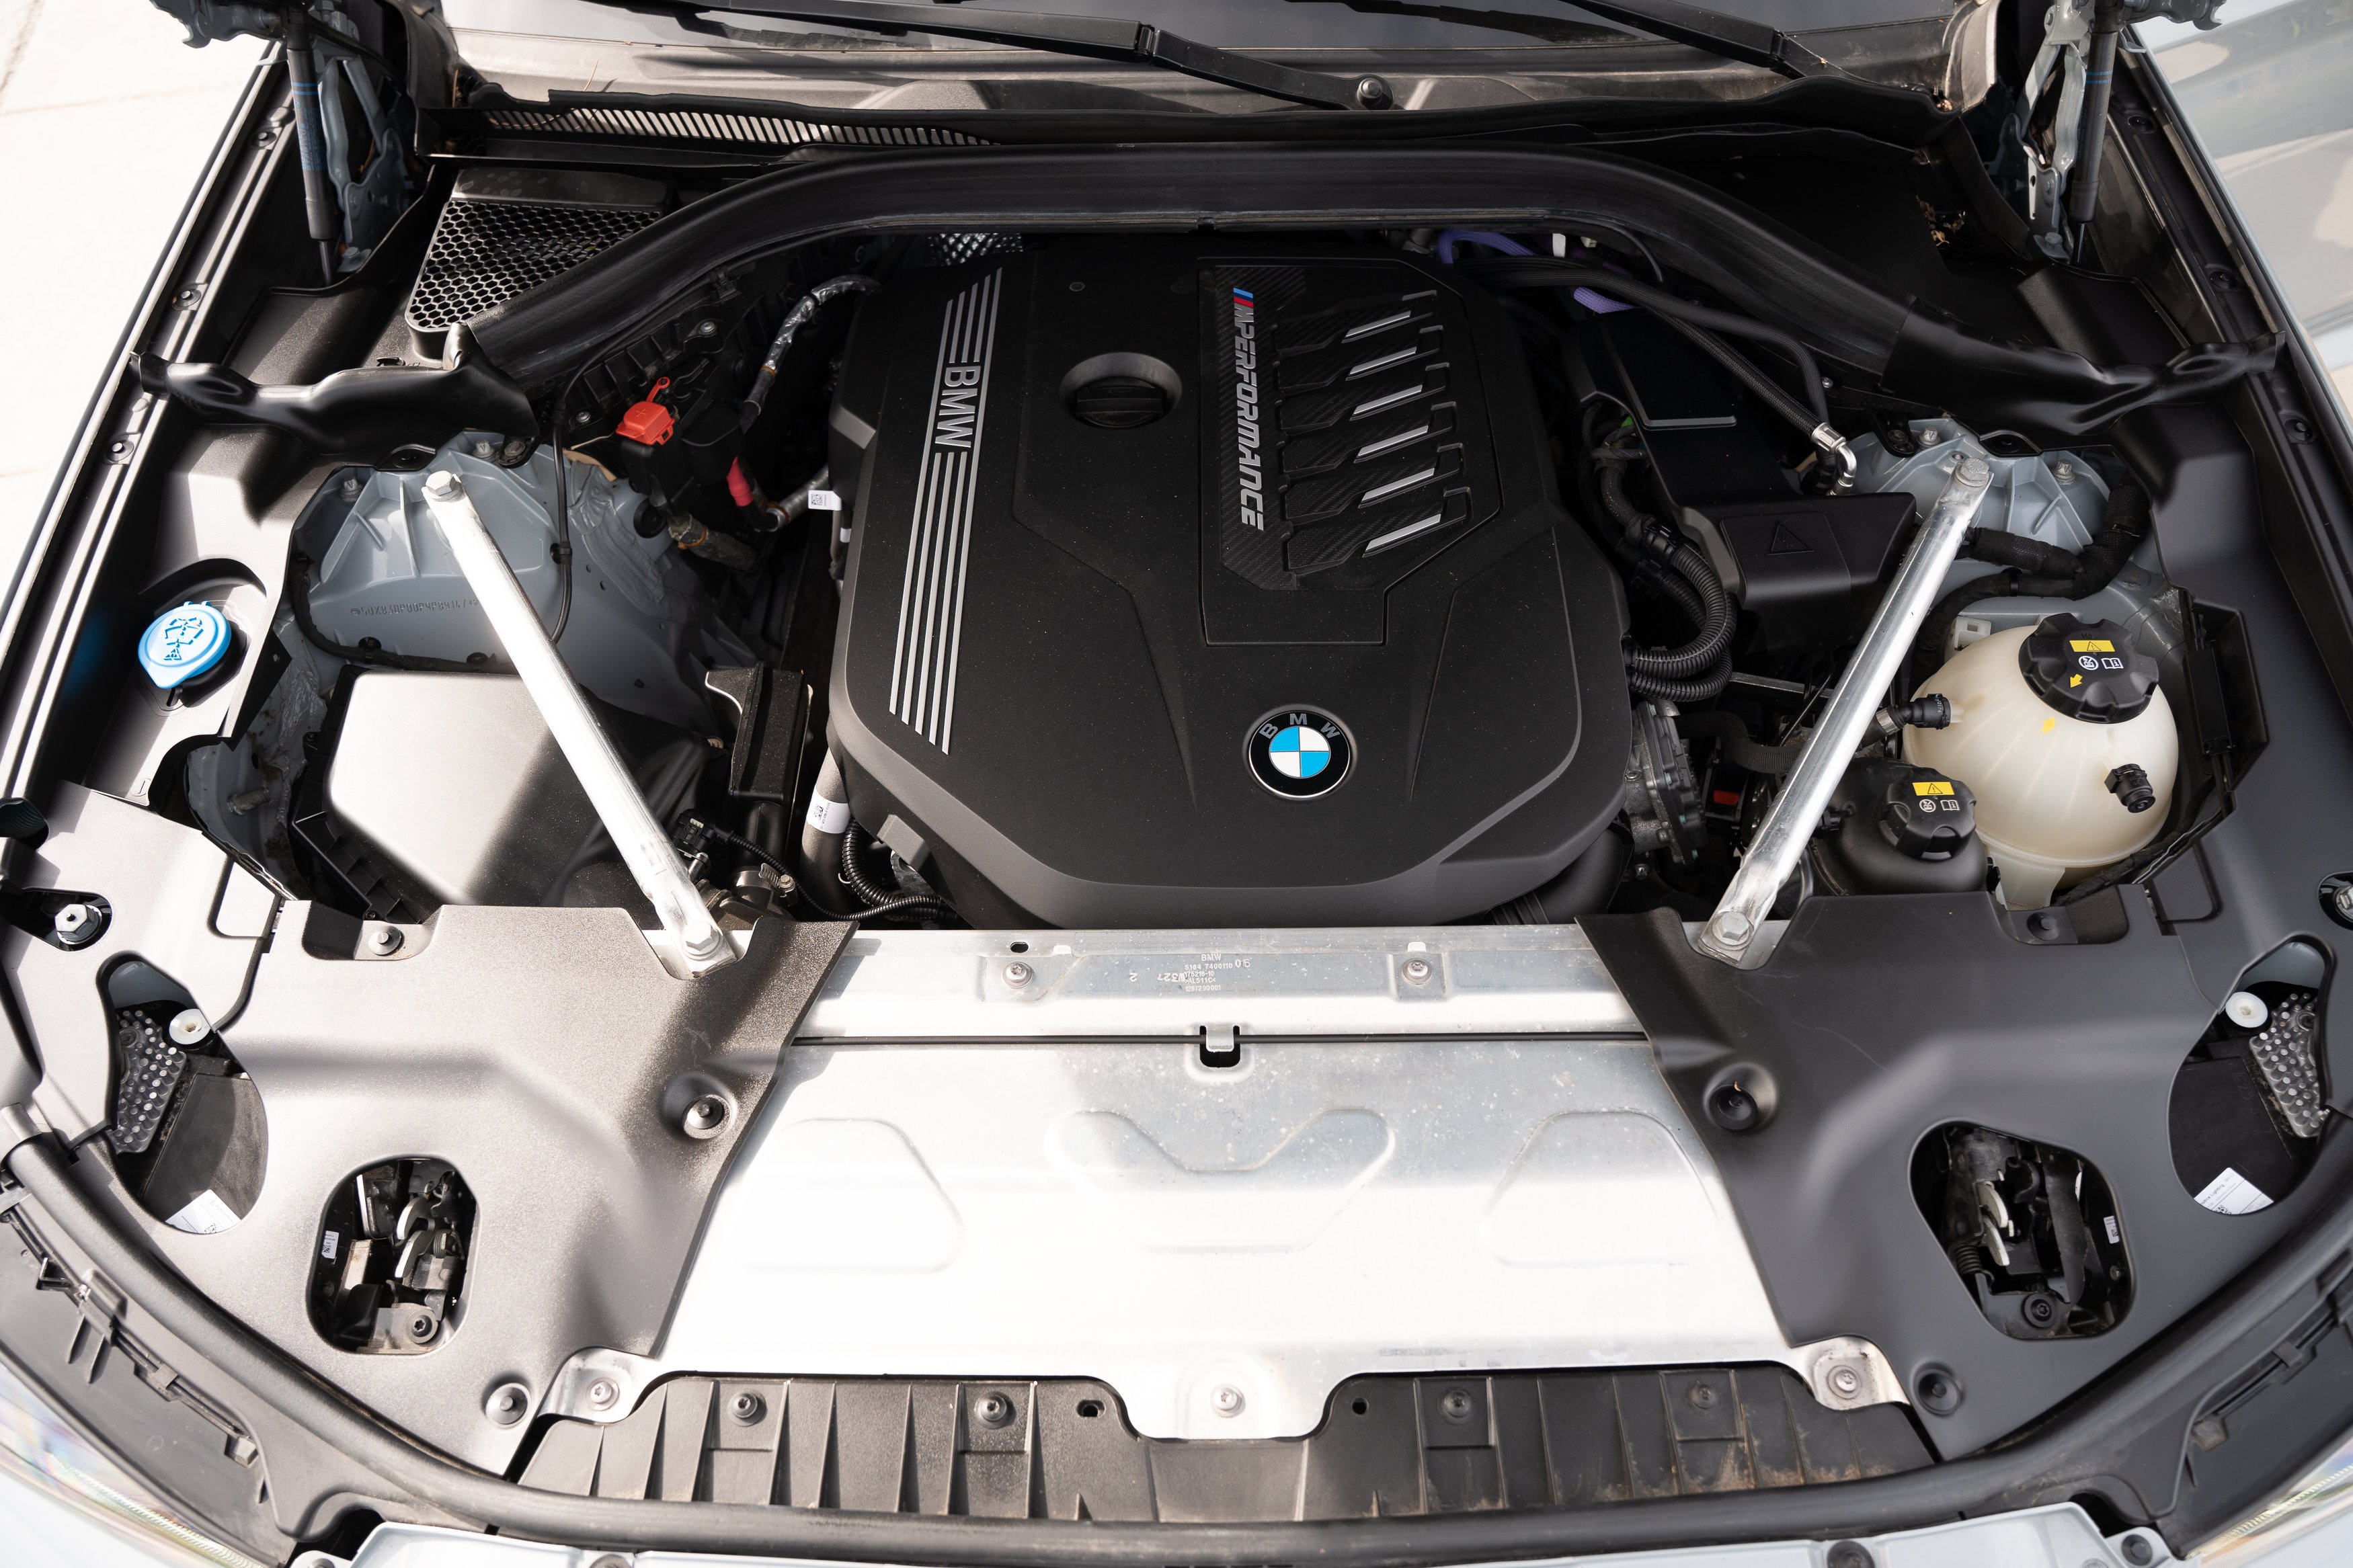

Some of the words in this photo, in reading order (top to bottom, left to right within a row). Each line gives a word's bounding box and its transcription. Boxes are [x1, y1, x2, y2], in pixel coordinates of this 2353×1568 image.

[935, 366, 981, 448] BMW
[1259, 713, 1341, 739] BMW
[1201, 954, 1222, 962] BMW
